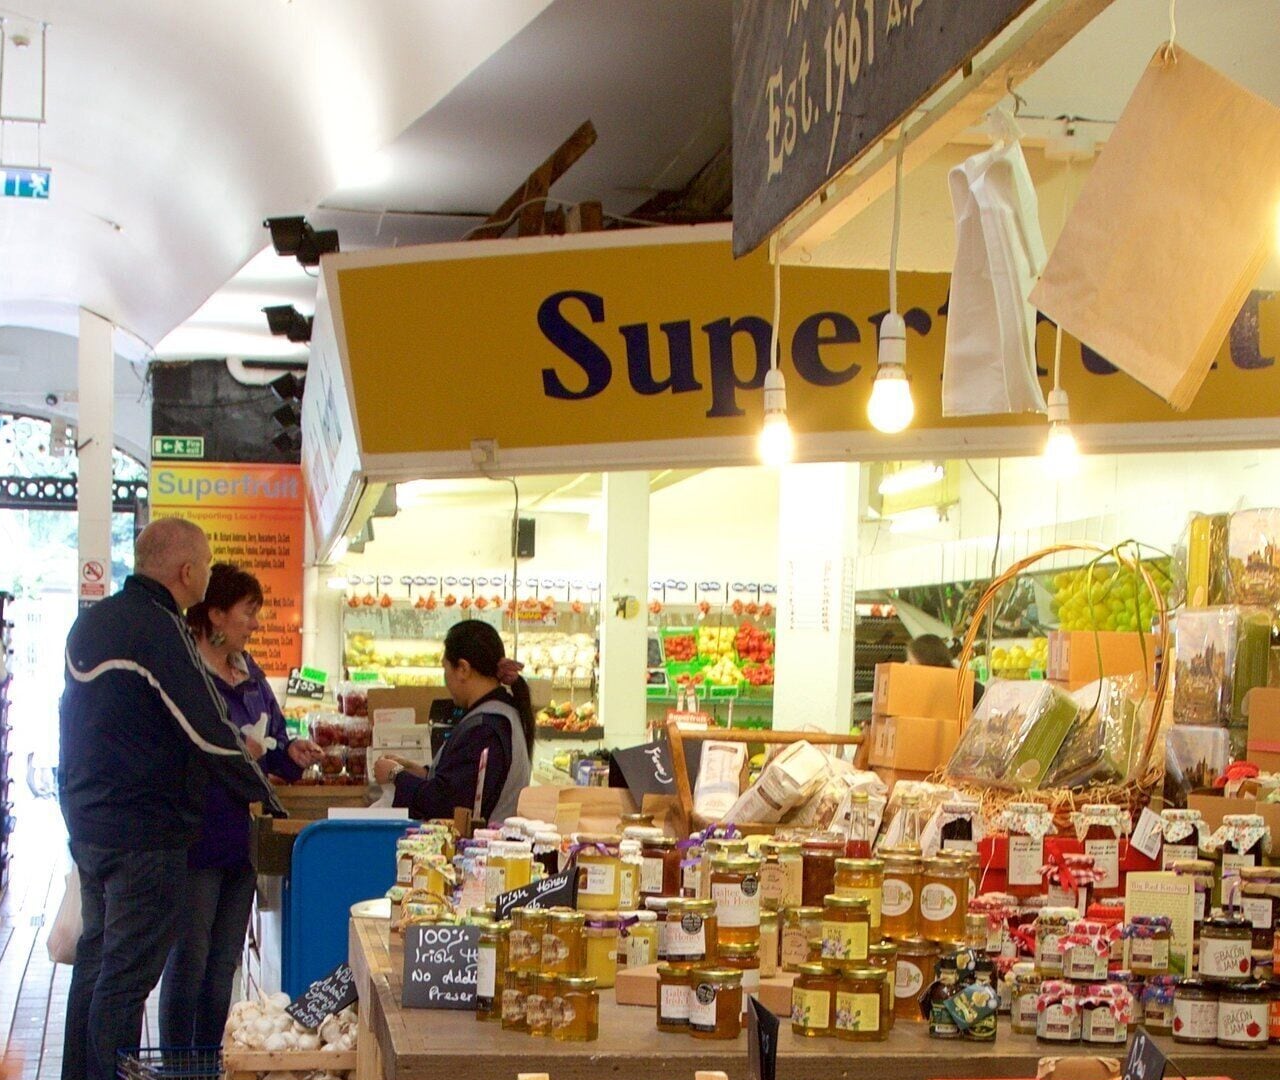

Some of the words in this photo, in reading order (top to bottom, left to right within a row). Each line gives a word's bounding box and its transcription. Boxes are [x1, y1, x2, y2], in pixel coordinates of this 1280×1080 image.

[540, 288, 1277, 420] Supert
[157, 471, 297, 500] Superfruit
[499, 889, 529, 914] Irish
[415, 947, 456, 964] Irish
[412, 968, 431, 983] No
